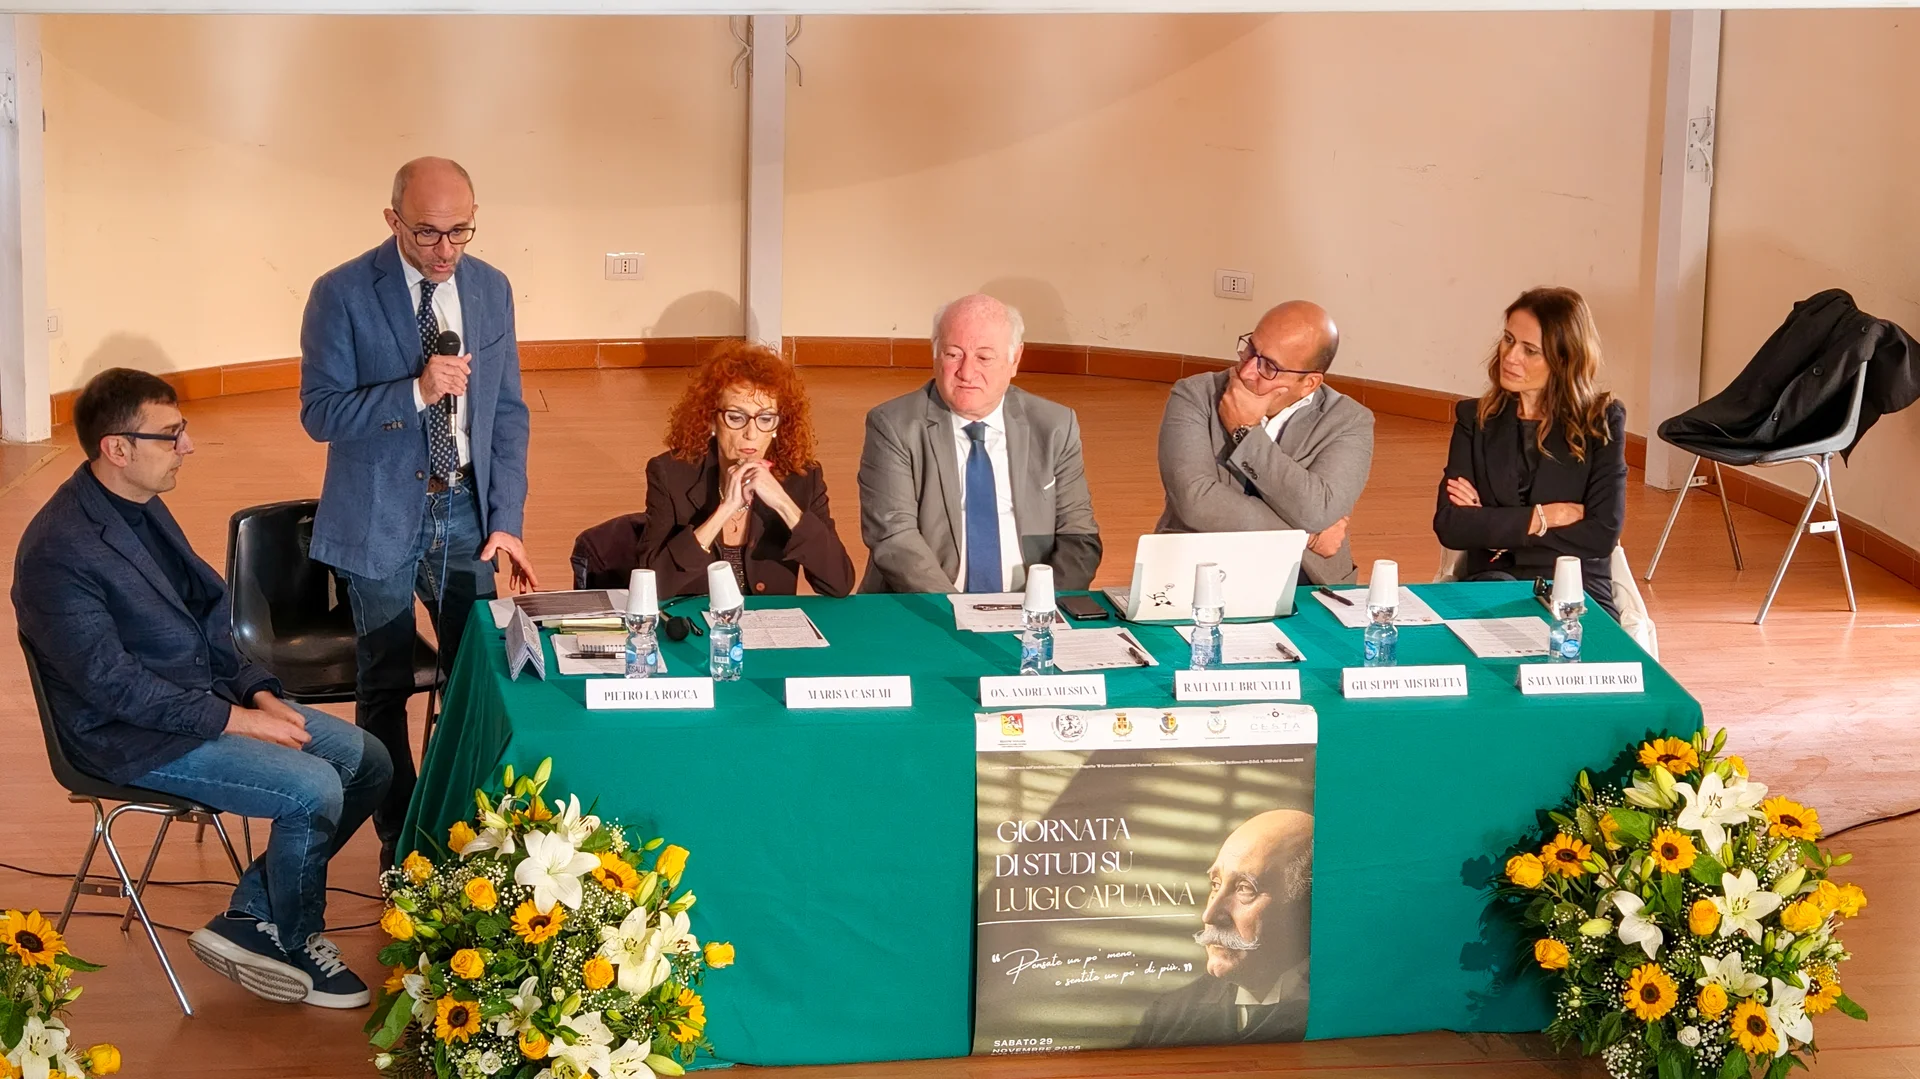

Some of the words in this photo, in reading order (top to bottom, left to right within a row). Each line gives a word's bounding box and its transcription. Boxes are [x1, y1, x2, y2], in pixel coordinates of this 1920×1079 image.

[1352, 679, 1401, 690] GIUSEPPE
[1403, 677, 1462, 689] MISTRETTA
[1528, 675, 1587, 686] SALVATORE
[1588, 674, 1638, 686] FERRARO
[604, 690, 643, 701] PIETRO
[645, 690, 660, 701] LA
[662, 689, 698, 700] ROCCA
[808, 689, 850, 700] MARISA
[990, 688, 1009, 698] ON.
[1011, 686, 1052, 697] ANDREA
[1053, 685, 1098, 696] MESSINA
[996, 817, 1131, 843] GIORNATA
[996, 853, 1018, 877] DI
[1022, 851, 1096, 876] STUDI
[1100, 850, 1133, 873] SU
[996, 886, 1060, 912] LUIGI
[1064, 881, 1195, 910] CAPUANA
[1067, 957, 1081, 965] un
[1064, 968, 1100, 986] sentite
[1144, 961, 1156, 974] di
[993, 1038, 1037, 1047] SABATO
[1039, 1037, 1053, 1045] 29
